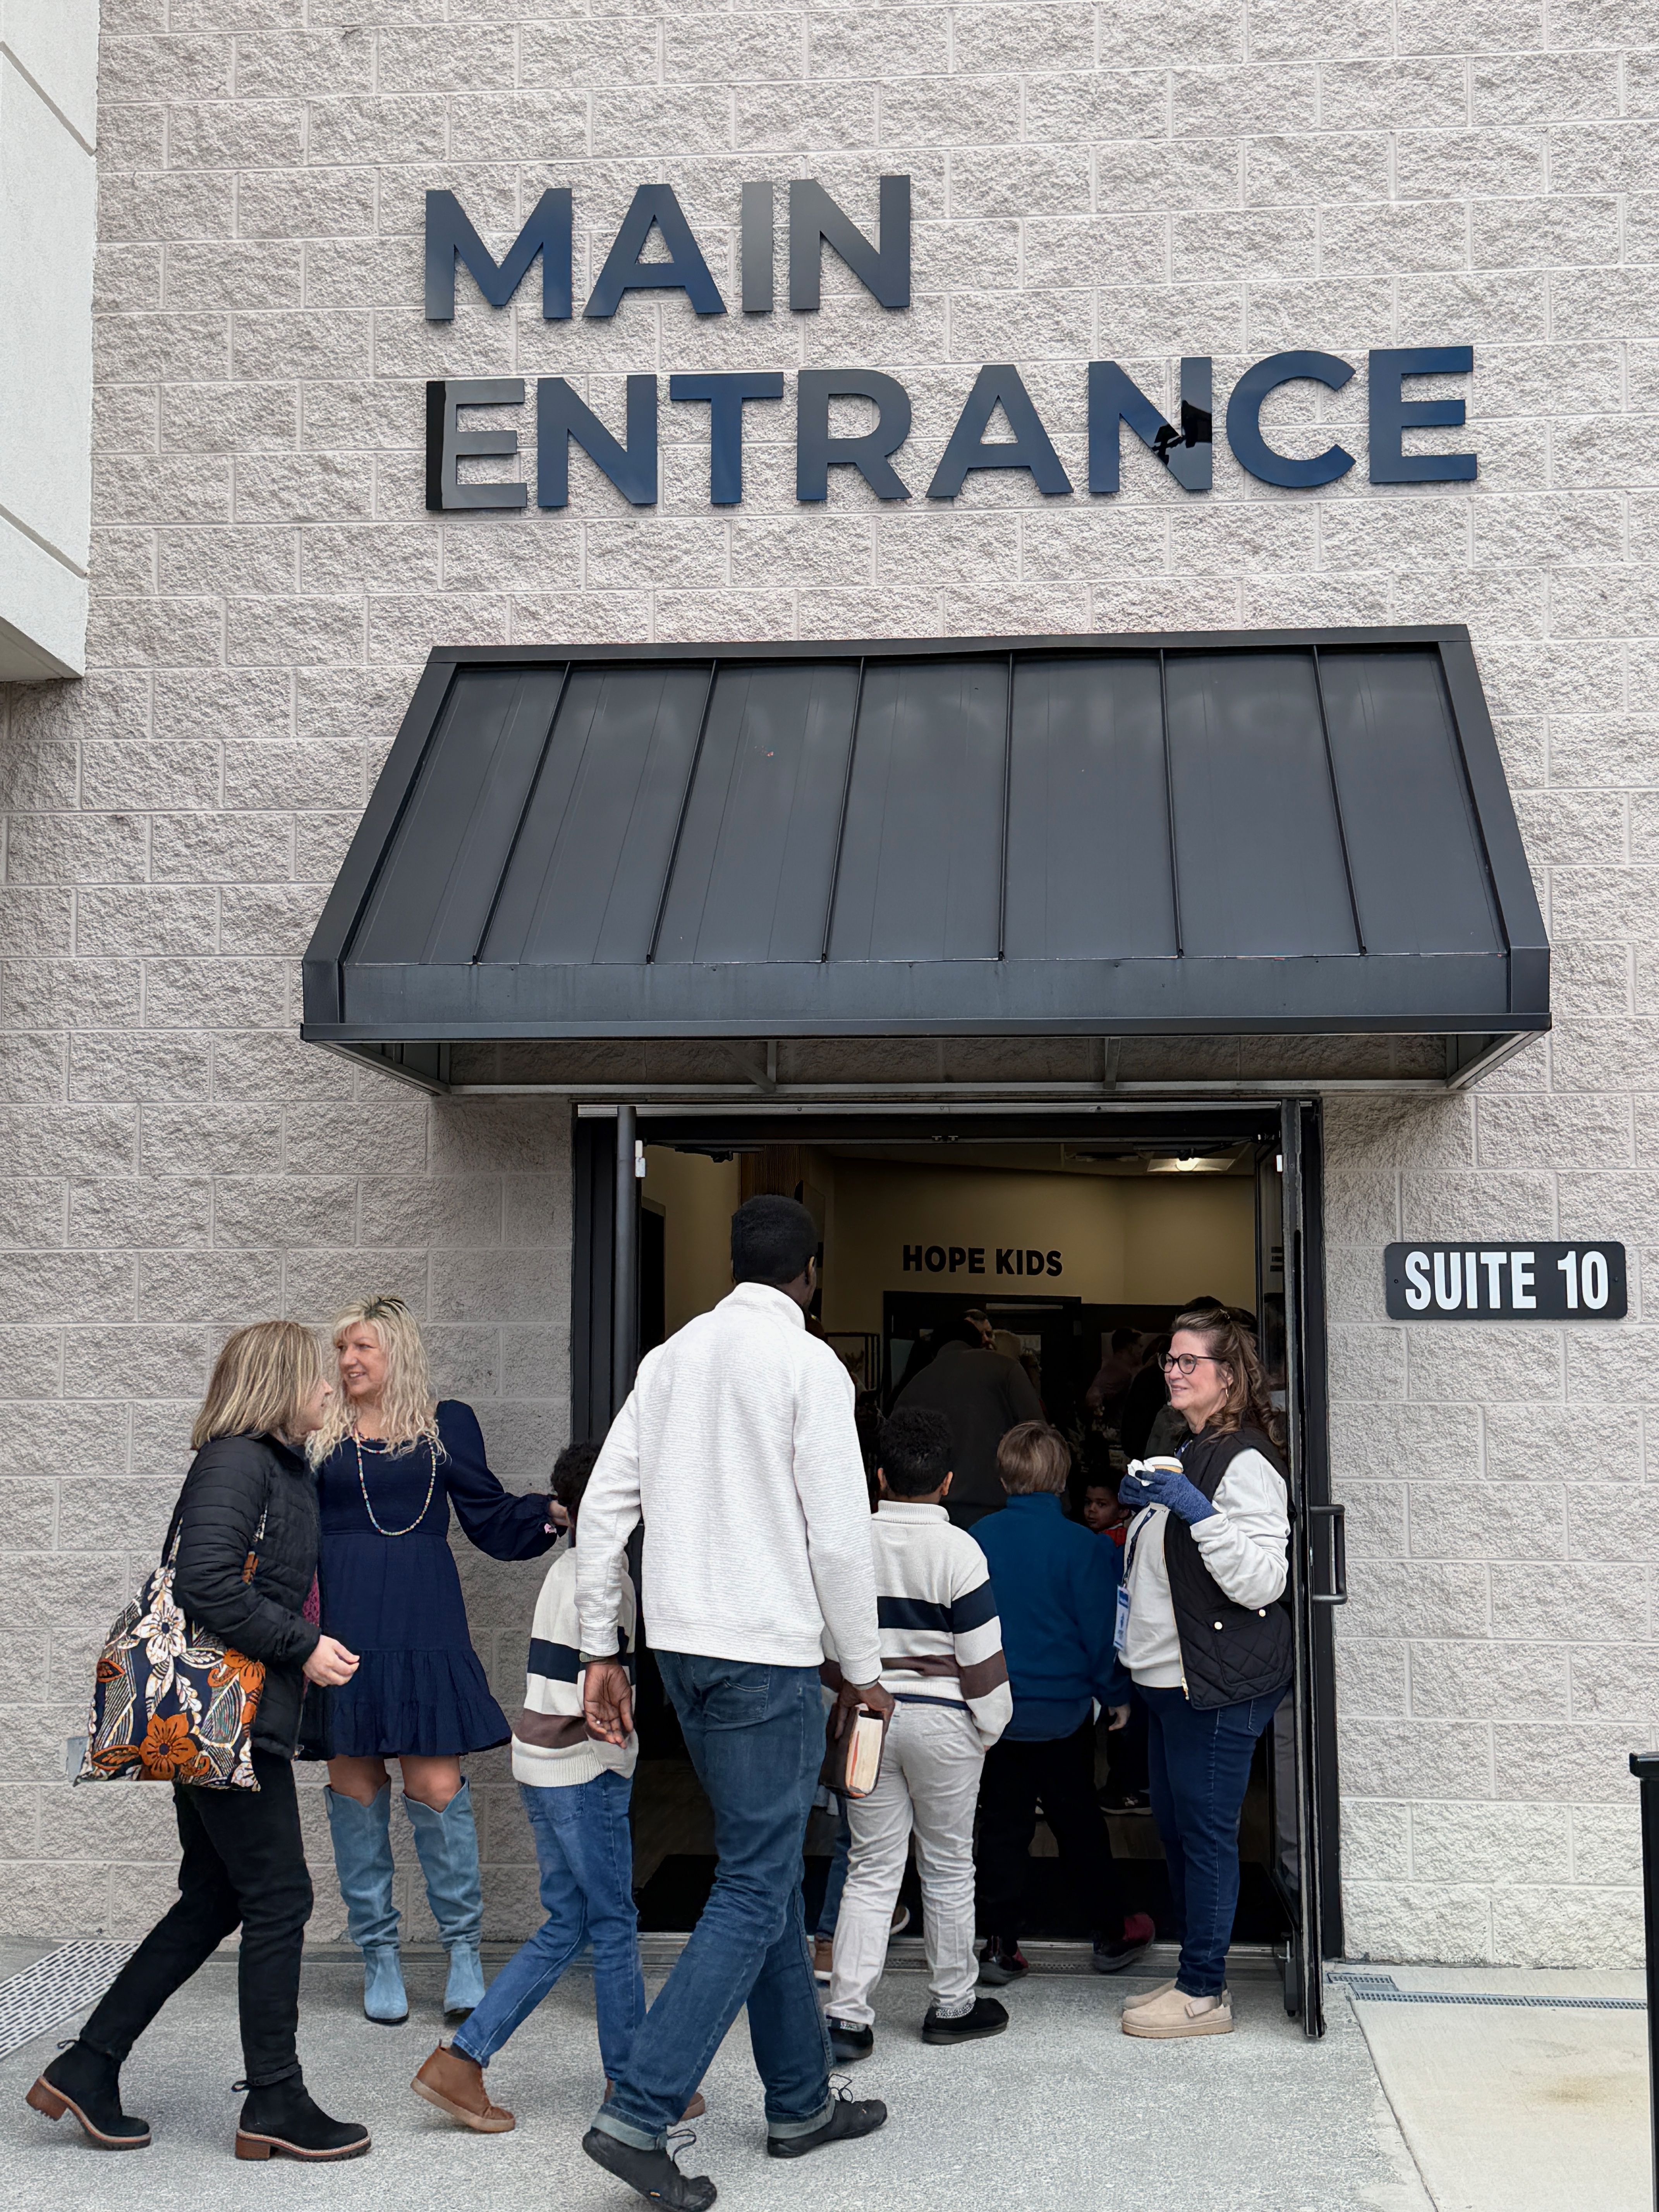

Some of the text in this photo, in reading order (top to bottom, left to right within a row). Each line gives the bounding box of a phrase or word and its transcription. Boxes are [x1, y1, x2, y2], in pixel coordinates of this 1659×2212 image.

[425, 175, 911, 320] MAIN
[426, 345, 1478, 510] ENTRANCE
[903, 1245, 1063, 1276] HOPE KIDS
[1405, 1251, 1608, 1310] SUITE 10
